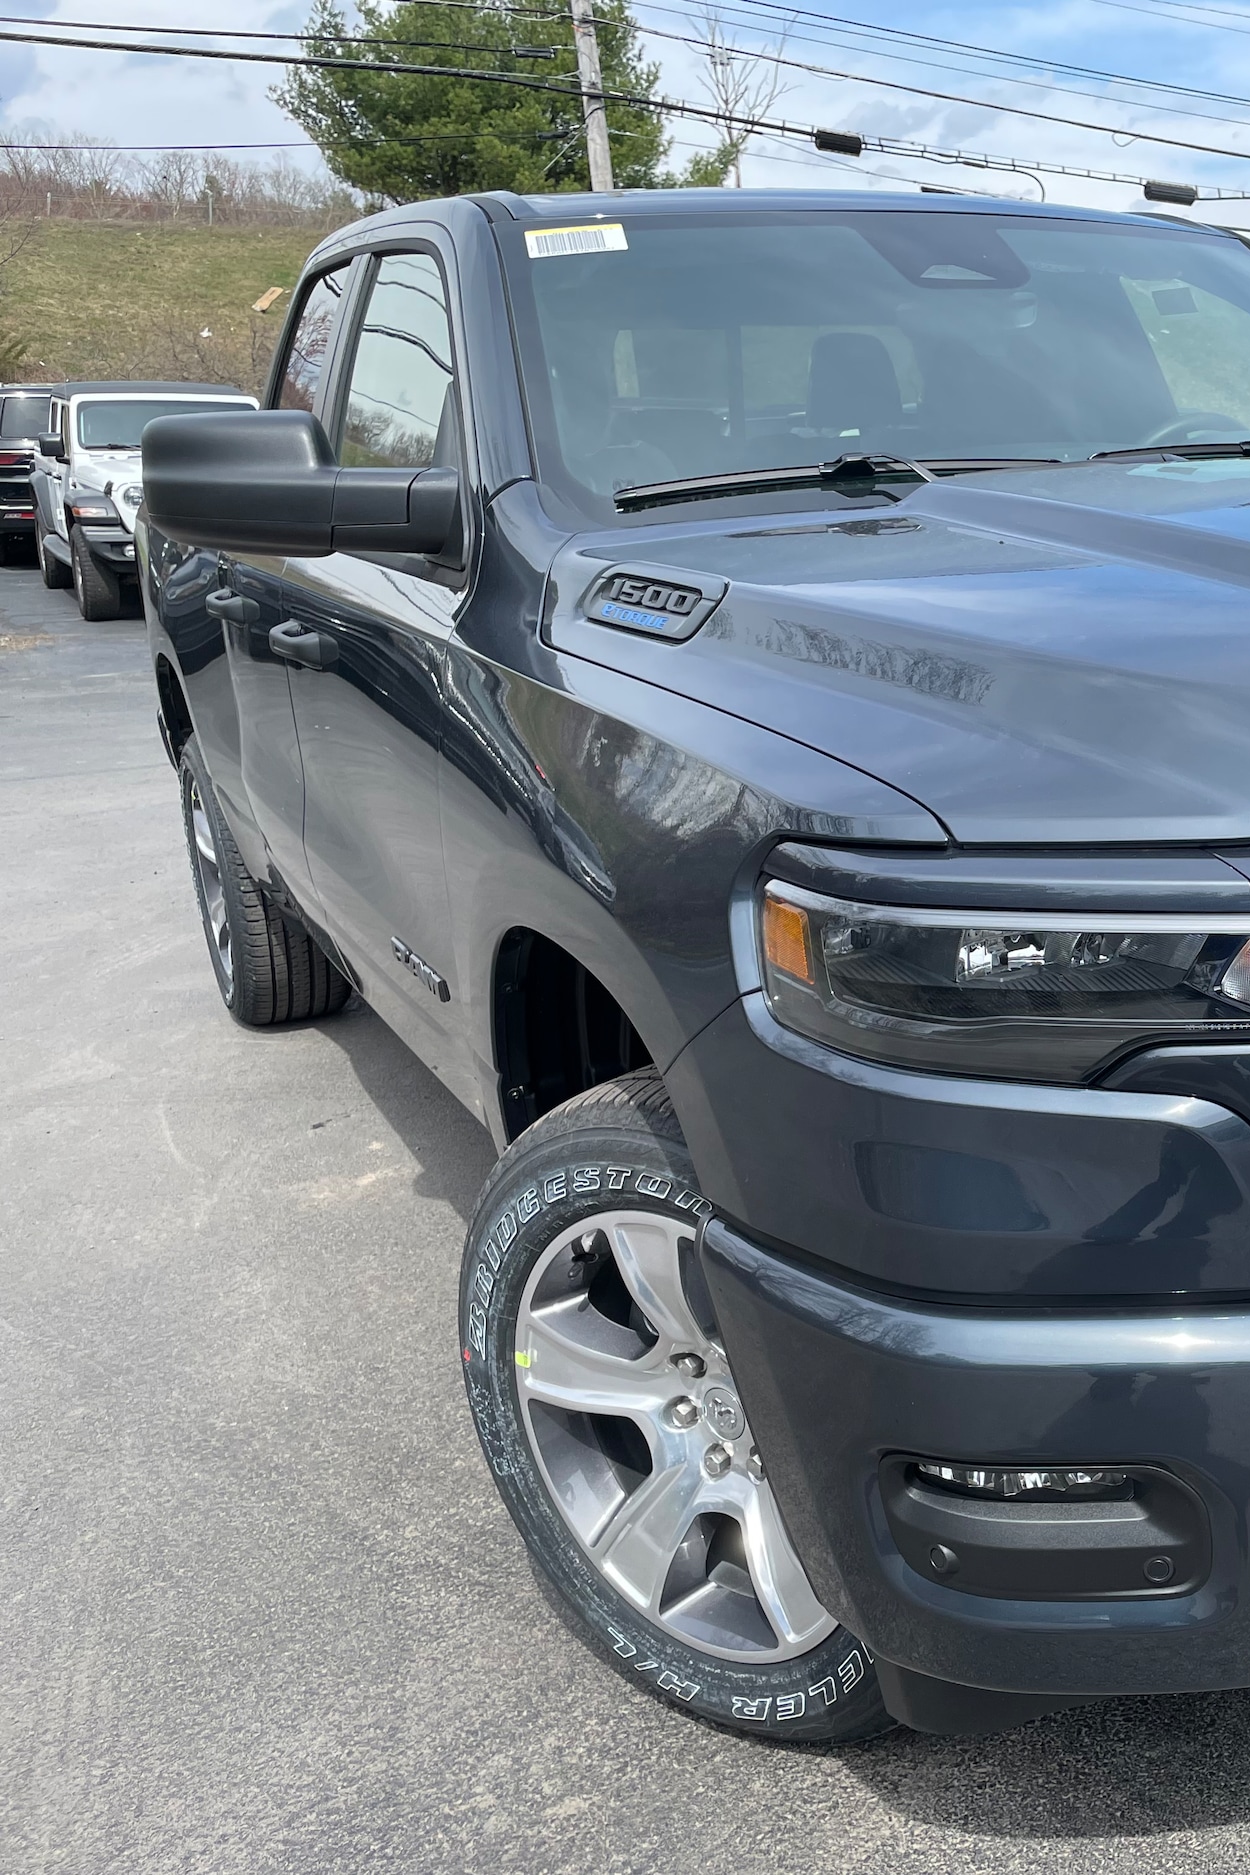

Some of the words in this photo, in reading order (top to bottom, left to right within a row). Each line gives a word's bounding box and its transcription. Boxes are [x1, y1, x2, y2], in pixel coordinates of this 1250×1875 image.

[609, 577, 699, 614] 1500
[601, 603, 669, 630] eTORQUE
[731, 1641, 875, 1721] ELER
